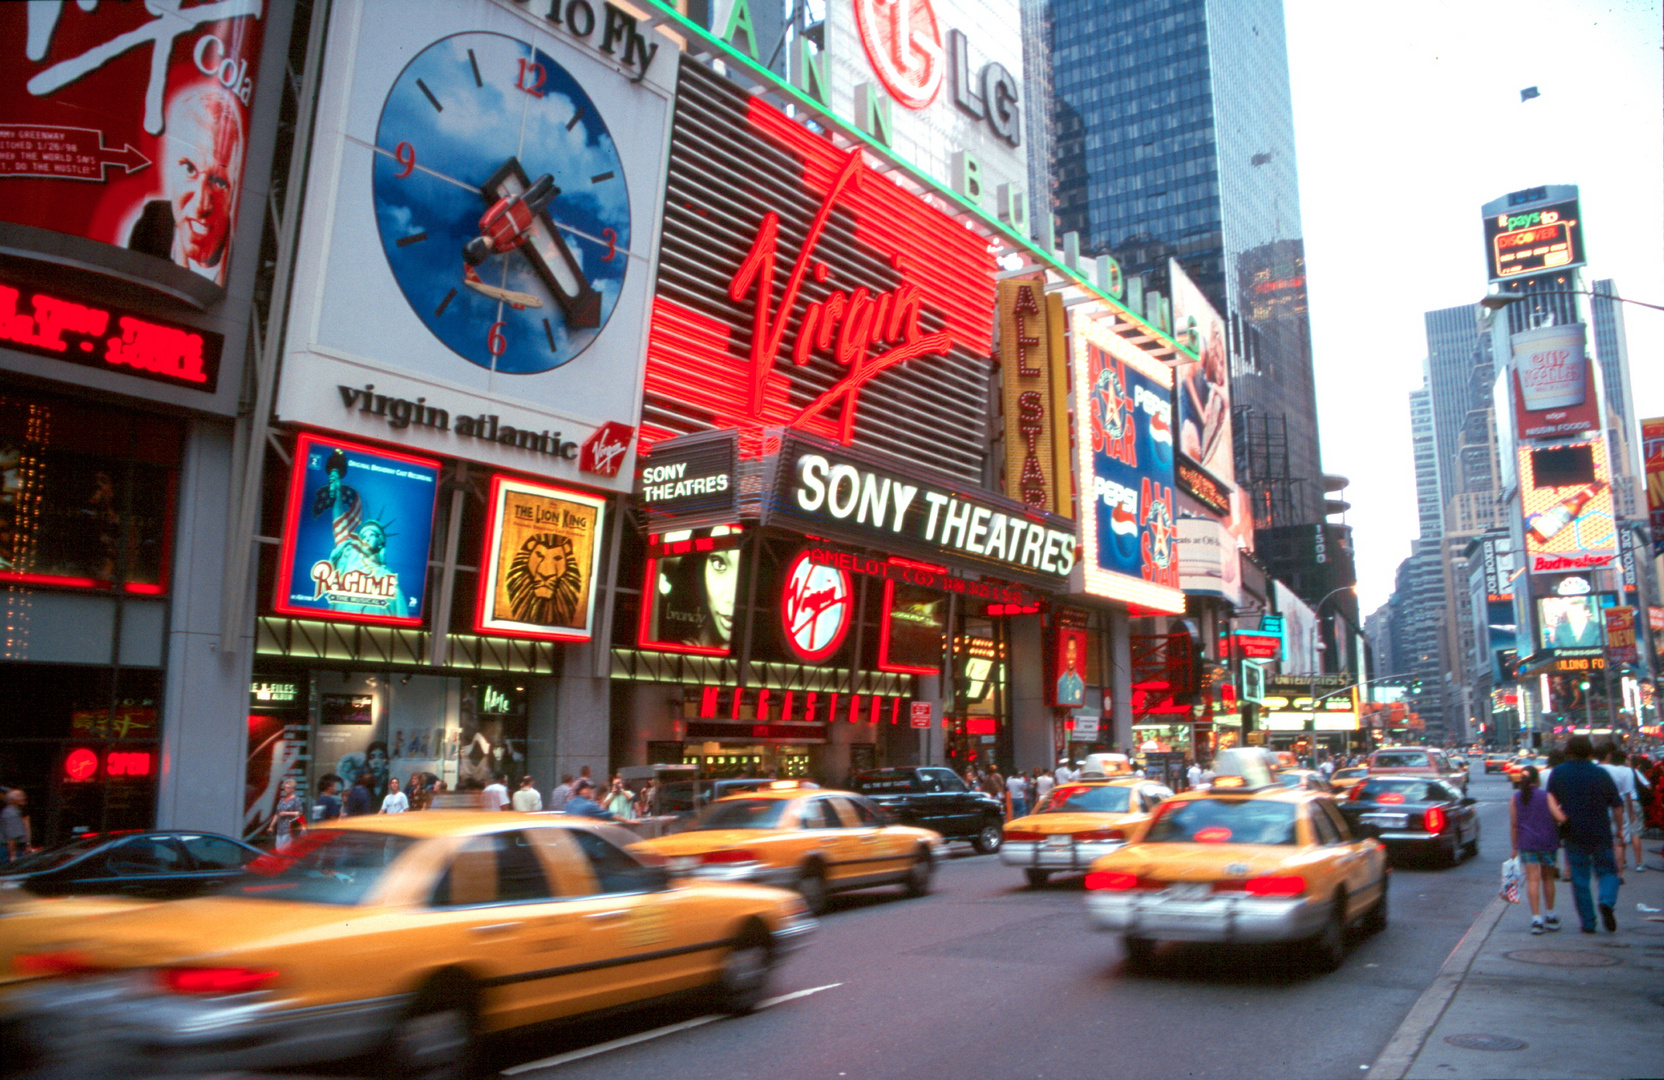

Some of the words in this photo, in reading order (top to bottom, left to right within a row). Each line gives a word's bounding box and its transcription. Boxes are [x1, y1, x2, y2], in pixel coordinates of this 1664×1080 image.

[193, 34, 254, 107] Cola
[514, 57, 548, 99] 12
[946, 28, 1021, 148] LG
[394, 142, 415, 179] 9
[1498, 225, 1558, 249] DISCOVER
[1508, 212, 1540, 231] pays
[1540, 211, 1559, 225] to
[600, 228, 617, 261] 3
[951, 151, 1200, 358] BUILDING
[729, 146, 956, 447] Virgin
[486, 321, 507, 356] 6
[1013, 285, 1041, 378] ALL
[338, 384, 451, 430] virgin
[454, 414, 579, 461] atlantic
[1134, 384, 1172, 425] PEPSI
[1557, 421, 1592, 431] FOODS
[592, 428, 626, 474] Virgin
[643, 463, 687, 484] SONY
[643, 474, 728, 502] THEATRES
[1094, 475, 1138, 515] PEPSI
[797, 453, 918, 533] SONY
[925, 490, 1077, 577] THEATRES
[1315, 524, 1326, 563] 1500
[1533, 553, 1613, 571] Budweiser
[311, 560, 399, 600] RAGTIME
[666, 602, 707, 628] brandy
[700, 686, 900, 724] MEGASTORE
